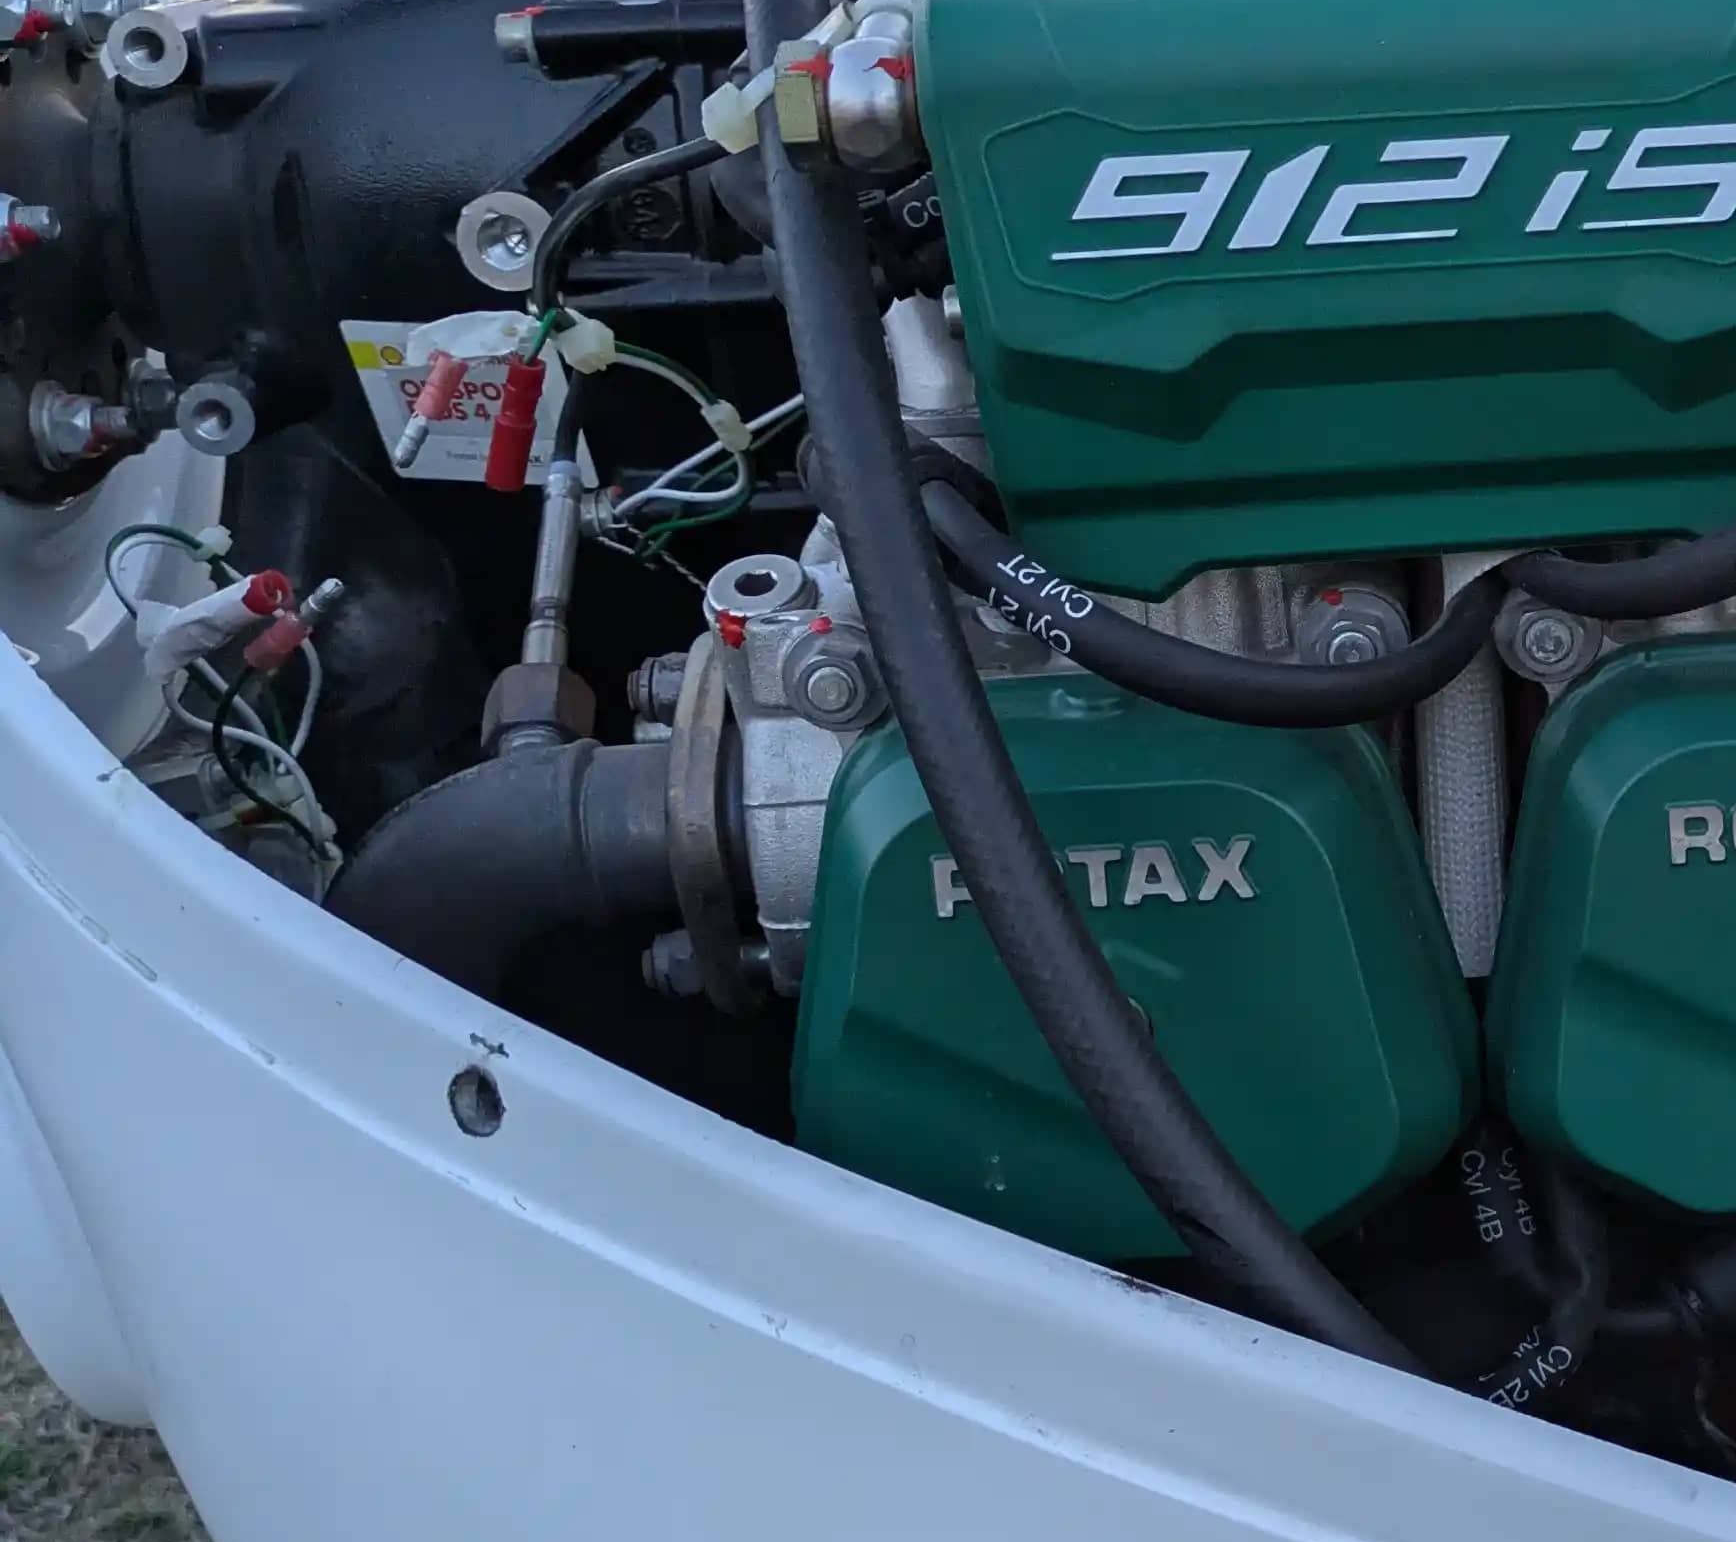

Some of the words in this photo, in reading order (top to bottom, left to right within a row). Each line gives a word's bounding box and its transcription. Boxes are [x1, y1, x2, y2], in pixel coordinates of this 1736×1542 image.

[1052, 134, 1511, 261] 912
[996, 553, 1047, 585] 2T
[1040, 577, 1094, 618] Cyl
[1474, 1203, 1504, 1243] 4B
[1528, 1345, 1573, 1389] Cyl
